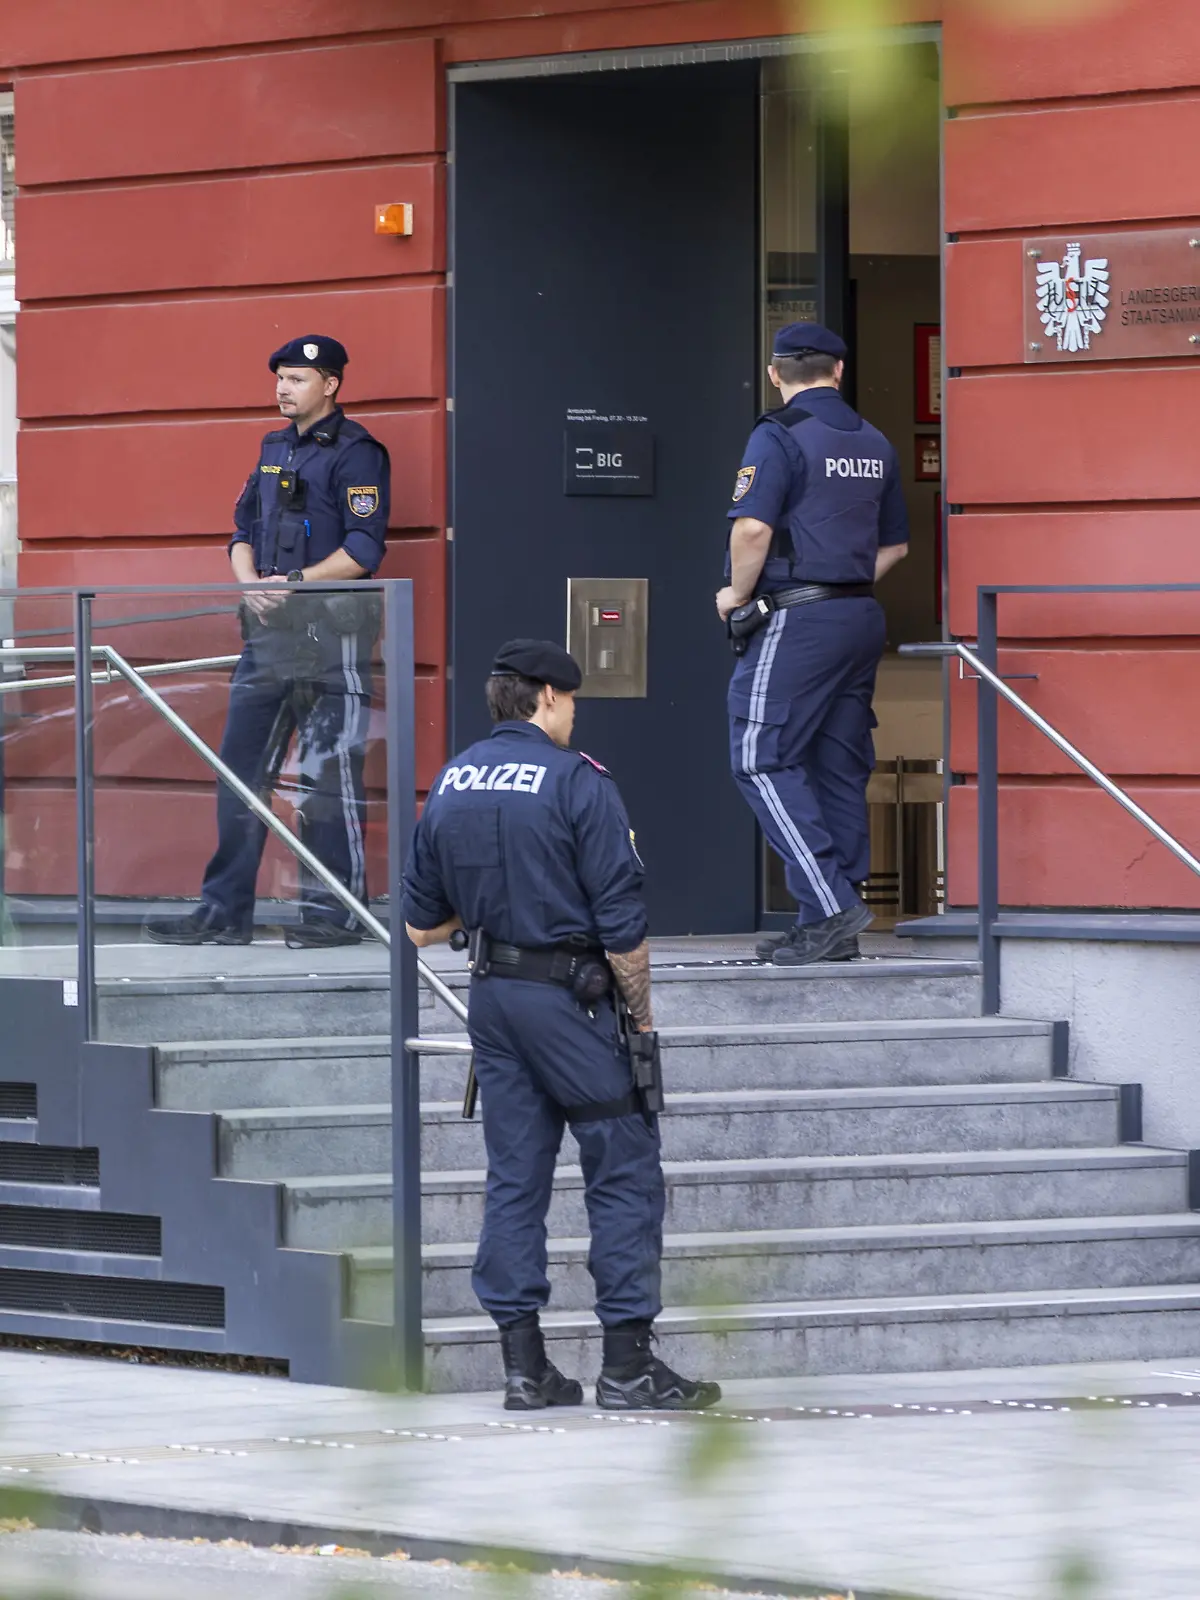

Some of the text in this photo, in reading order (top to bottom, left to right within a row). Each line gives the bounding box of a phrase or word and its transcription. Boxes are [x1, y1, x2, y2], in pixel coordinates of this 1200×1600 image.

[597, 453, 622, 467] BIG
[825, 457, 884, 479] POLIZEI
[437, 762, 547, 795] POLIZEI
